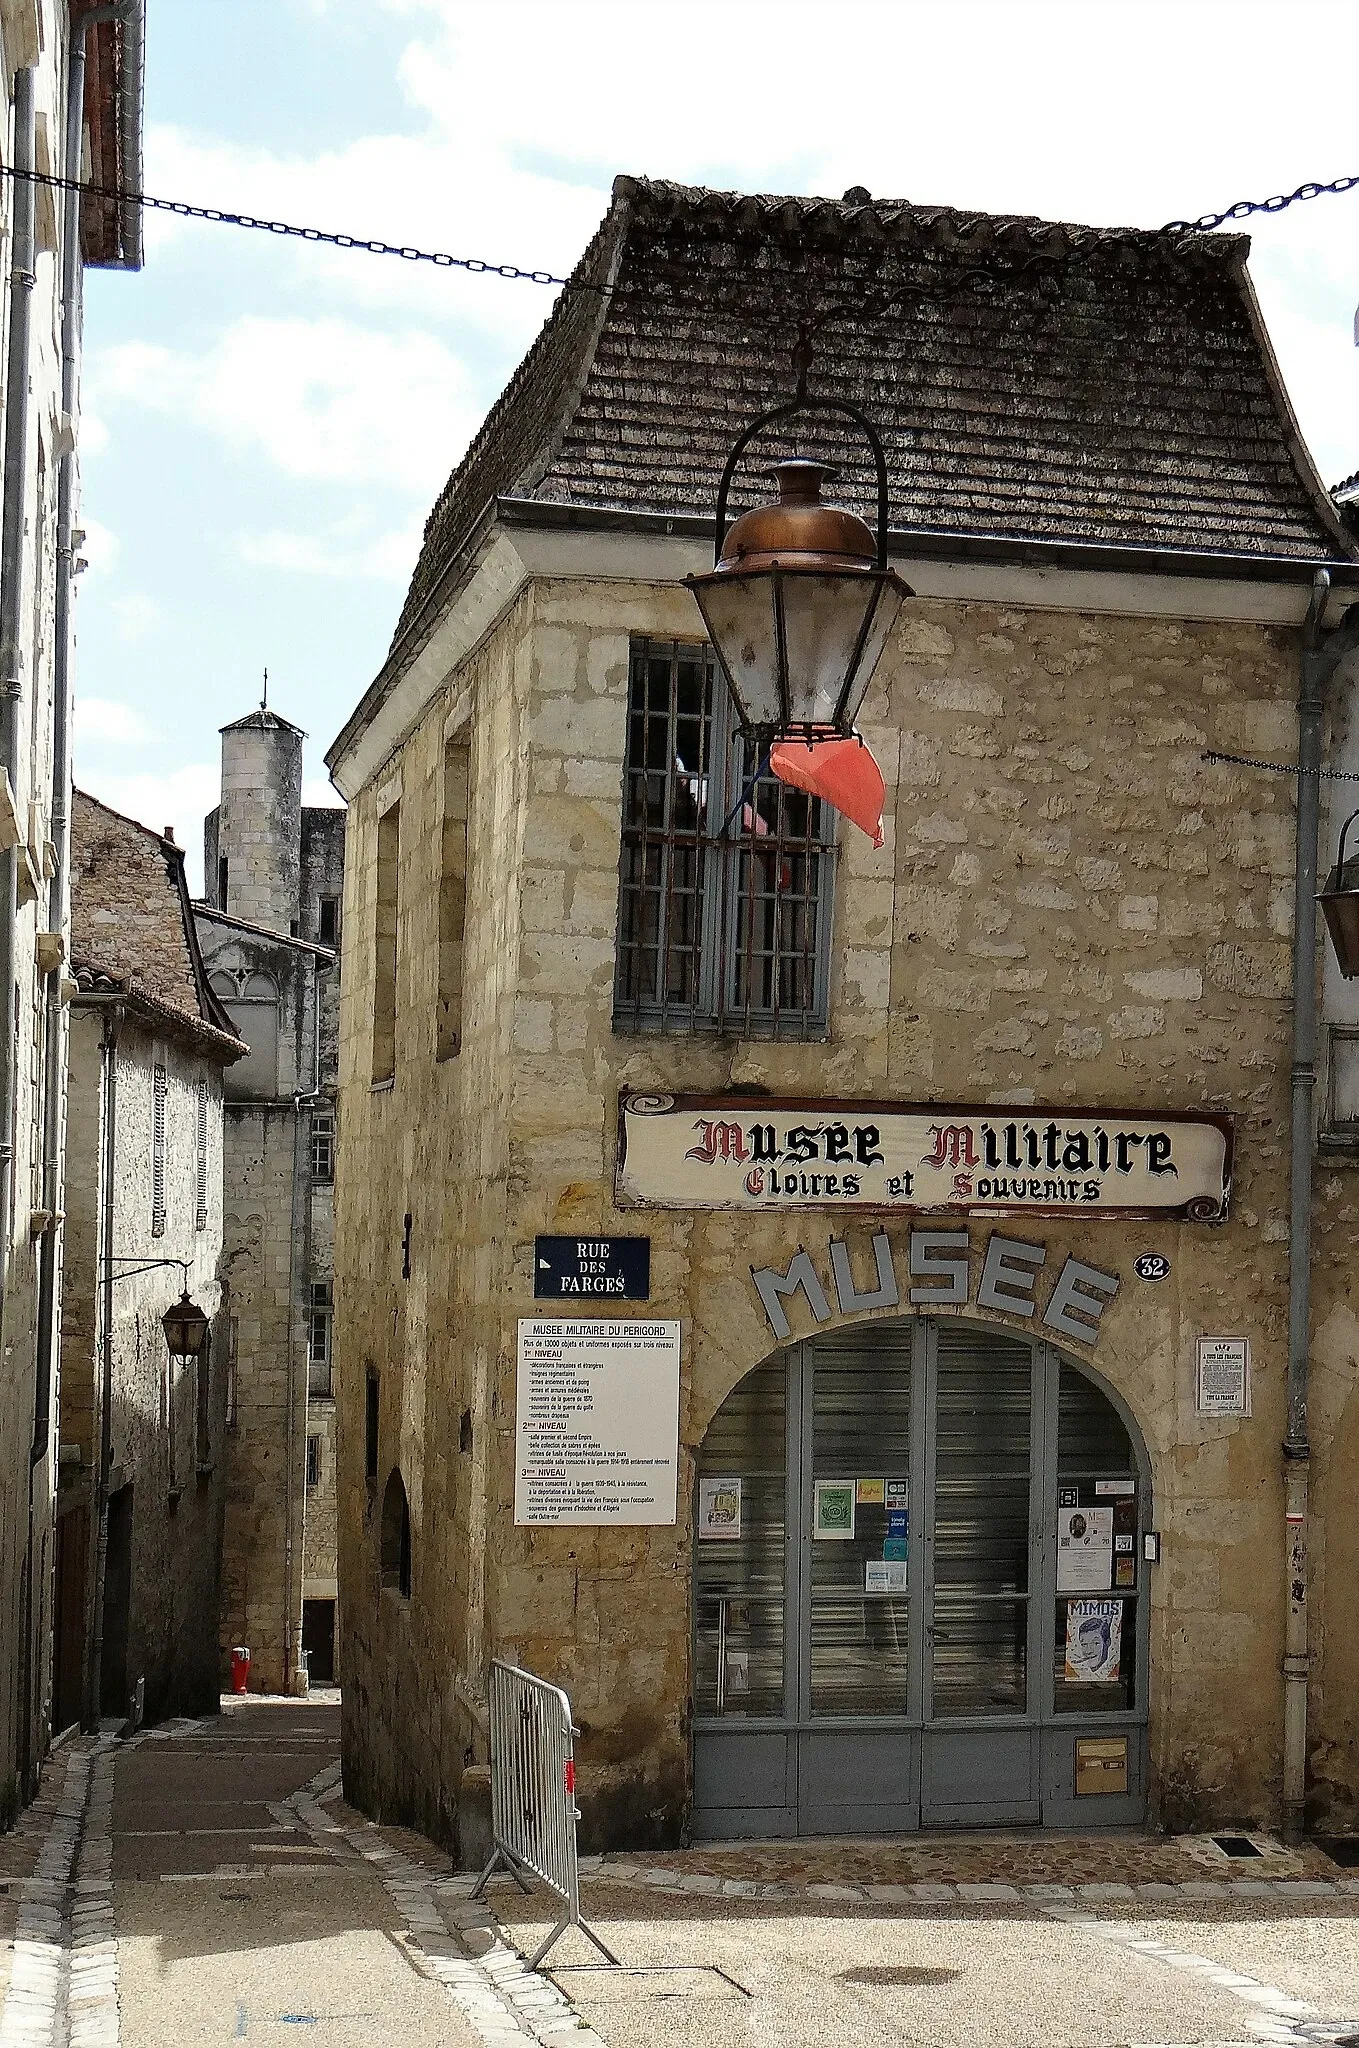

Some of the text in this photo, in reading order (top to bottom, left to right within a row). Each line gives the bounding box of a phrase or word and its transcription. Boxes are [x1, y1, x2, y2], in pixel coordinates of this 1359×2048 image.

[685, 1118, 1179, 1180] Musée Militaire
[746, 1166, 1103, 1203] Gloires et Souvenirs
[577, 1243, 610, 1258] RUE
[580, 1262, 606, 1273] DES
[1141, 1258, 1164, 1276] 32
[560, 1276, 625, 1292] FARGES
[752, 1232, 1120, 1344] MUSEE
[533, 1325, 665, 1335] MUSEE MILITAIRE DU PERIGORD
[1070, 1602, 1120, 1616] MIMOS
